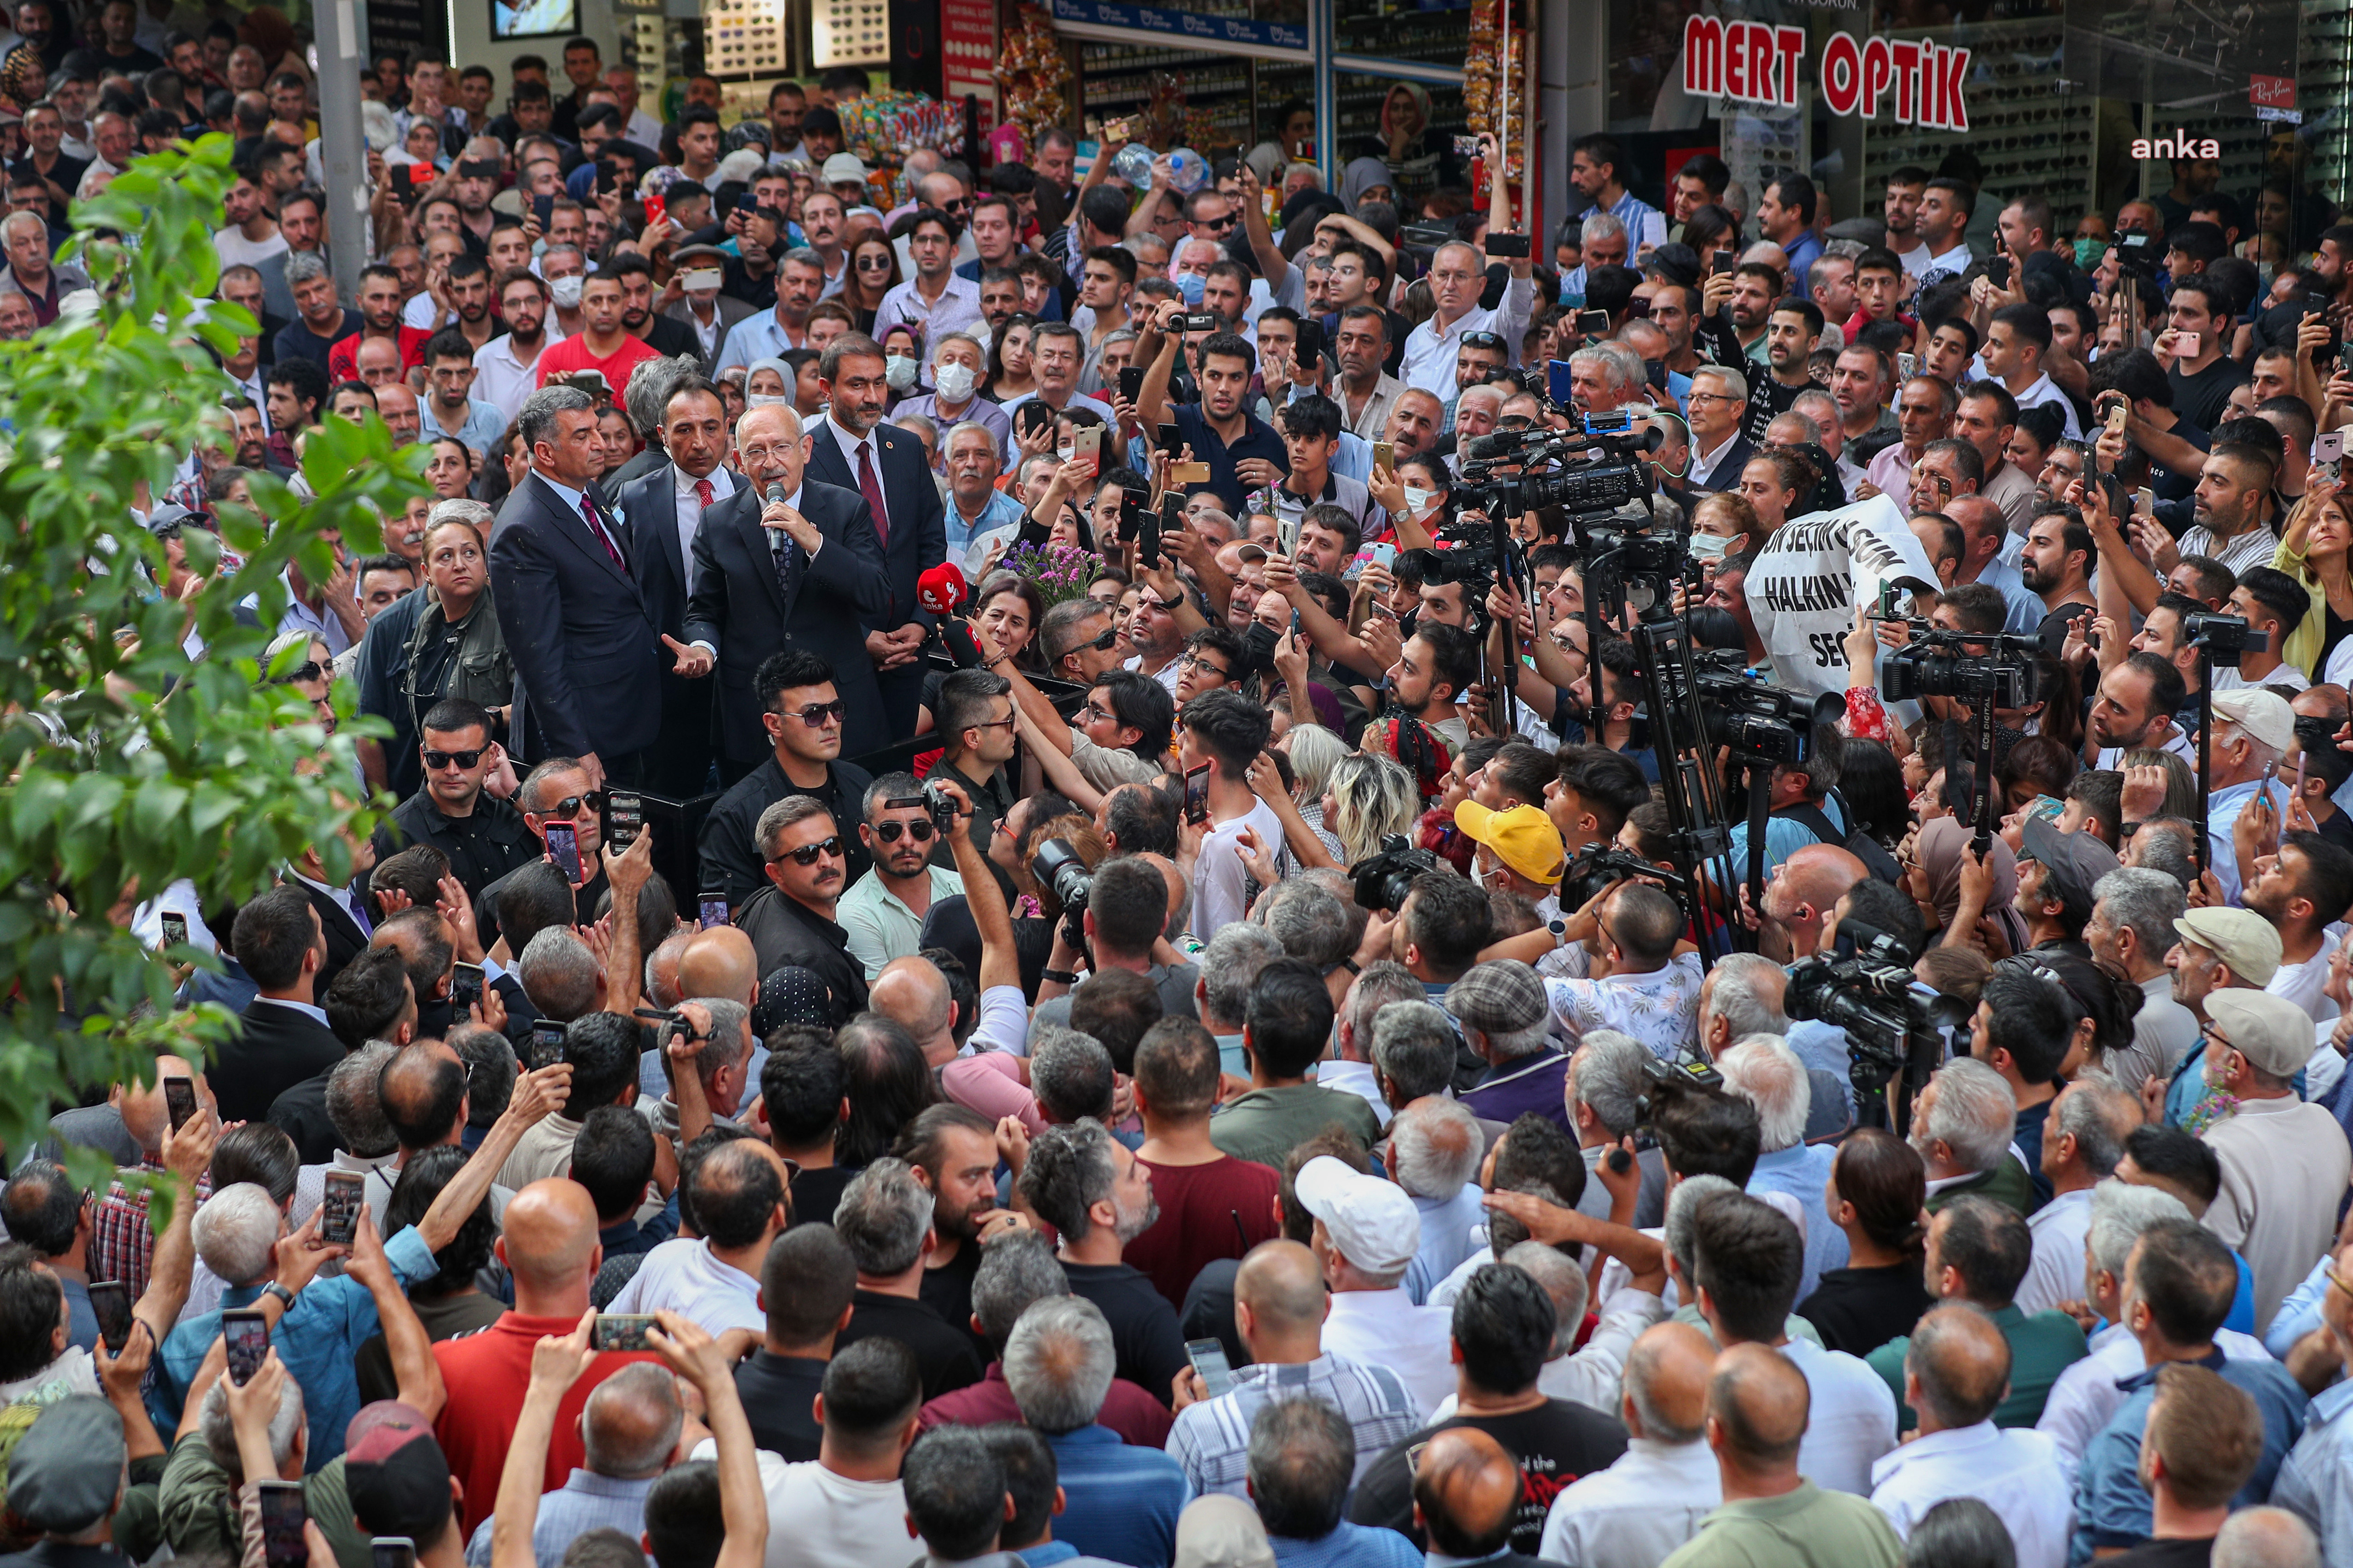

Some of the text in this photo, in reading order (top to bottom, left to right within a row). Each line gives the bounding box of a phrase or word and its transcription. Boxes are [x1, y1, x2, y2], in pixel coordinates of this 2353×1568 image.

[1684, 13, 1806, 107] MERT
[1631, 464, 1645, 487] SONY
[1834, 519, 1907, 575] OSUN
[1764, 572, 1848, 612] HALKIN
[1970, 795, 1984, 823] Canon
